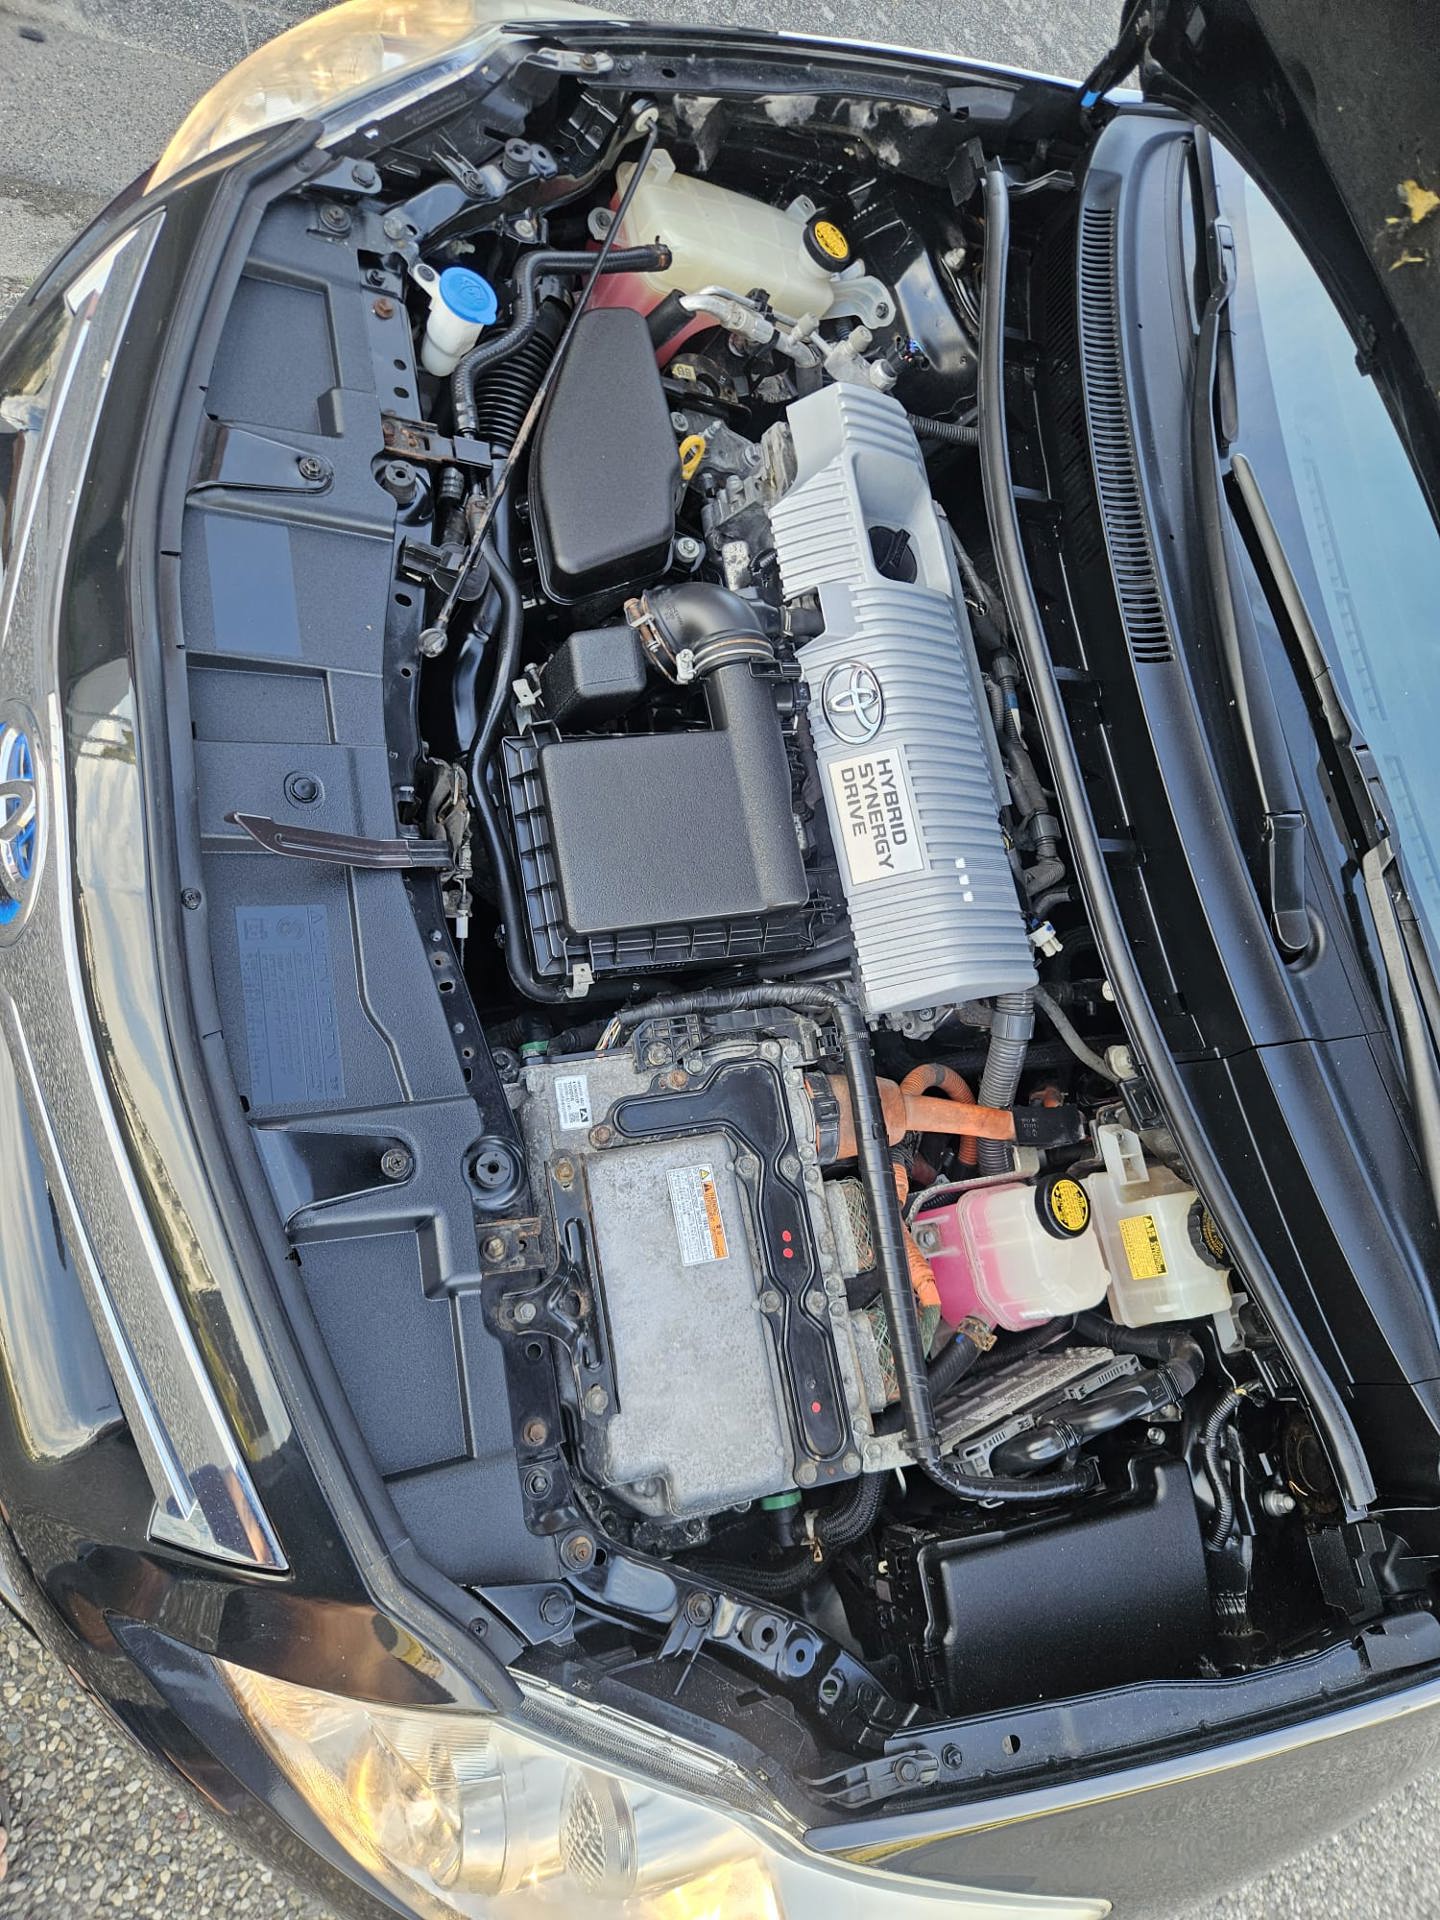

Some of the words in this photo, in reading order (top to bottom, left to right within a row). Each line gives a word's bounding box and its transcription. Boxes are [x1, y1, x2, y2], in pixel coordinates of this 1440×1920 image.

[841, 767, 868, 837] DRIVE
[858, 763, 894, 869] SYNERGY
[877, 759, 907, 845] HYBRID
